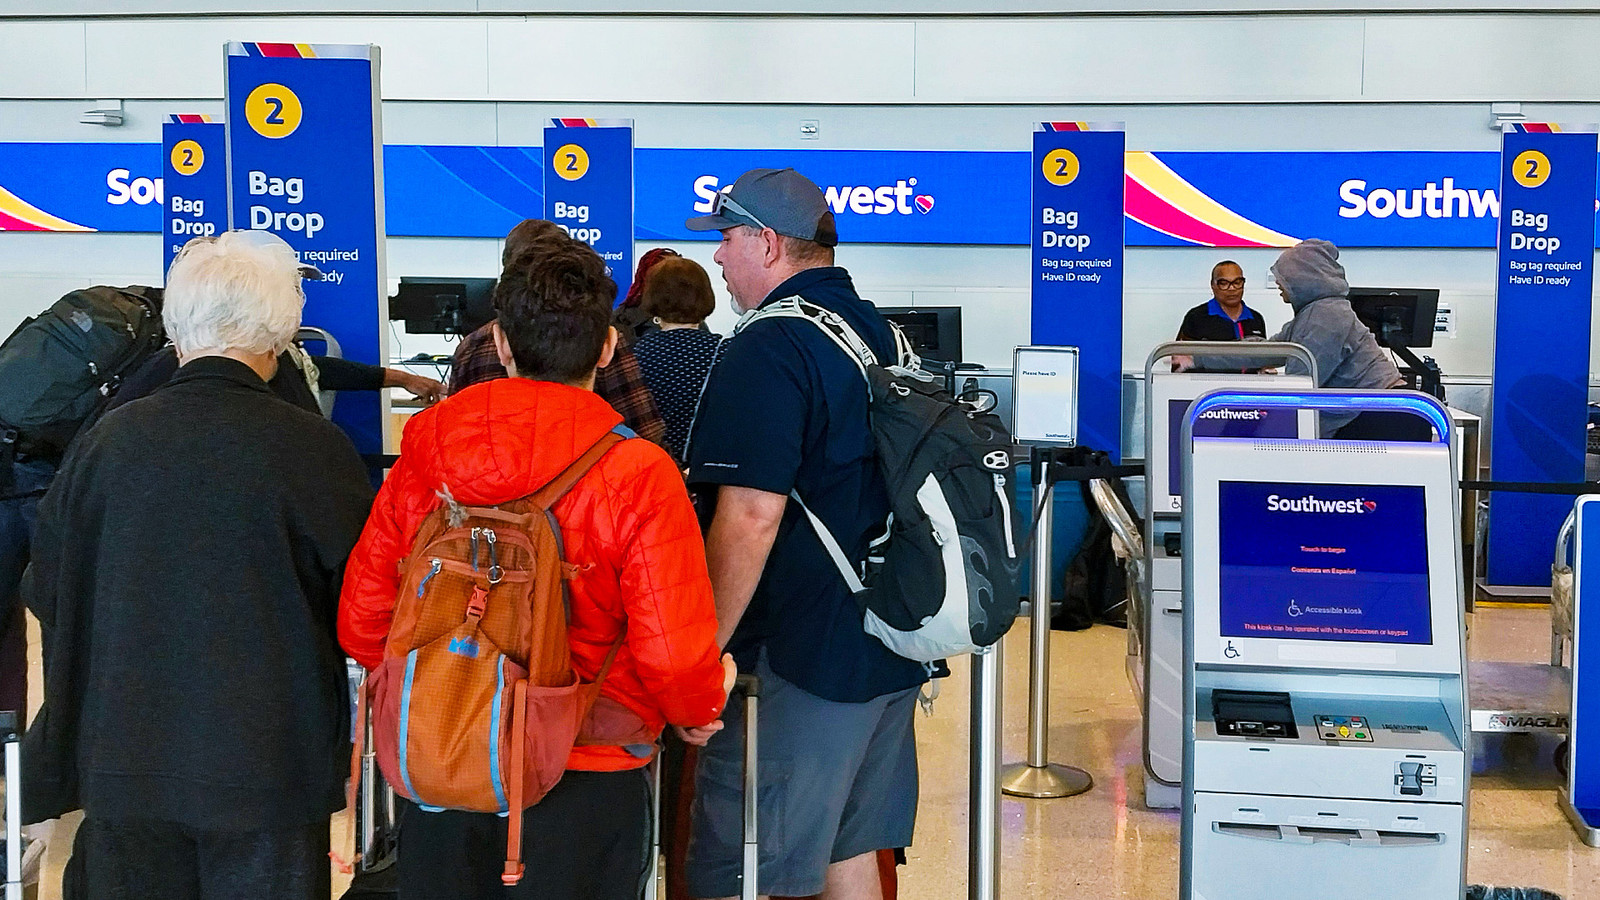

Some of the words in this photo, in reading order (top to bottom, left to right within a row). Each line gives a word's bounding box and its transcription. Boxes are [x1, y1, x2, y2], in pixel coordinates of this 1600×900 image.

[265, 98, 284, 124] 2
[183, 149, 194, 166] 2
[566, 154, 578, 171] 2
[1056, 158, 1068, 176] 2
[1526, 160, 1538, 178] 2
[249, 171, 304, 204] Bag
[693, 175, 914, 215] Swest
[172, 196, 204, 217] Bag
[554, 202, 589, 223] Bag
[172, 218, 215, 237] Drop
[250, 206, 324, 238] Drop
[1042, 208, 1078, 230] Bag
[1511, 210, 1548, 232] Bag
[1042, 231, 1090, 252] Drop
[1510, 232, 1560, 255] Drop
[304, 248, 359, 264] required
[1042, 258, 1058, 270] Bag
[1060, 259, 1074, 270] tag
[1076, 258, 1112, 270] required
[1510, 260, 1527, 272] Bag
[1528, 262, 1543, 272] tag
[1544, 261, 1582, 272] required
[1042, 272, 1064, 281] Have
[1066, 272, 1076, 281] ID
[1077, 272, 1102, 284] ready
[1510, 276, 1532, 284] Have
[1534, 276, 1544, 284] ID
[1546, 276, 1571, 288] ready
[1267, 495, 1365, 514] Southwest
[1305, 606, 1342, 614] Accessible
[1344, 606, 1362, 615] kiosk
[1387, 629, 1408, 637] keypad
